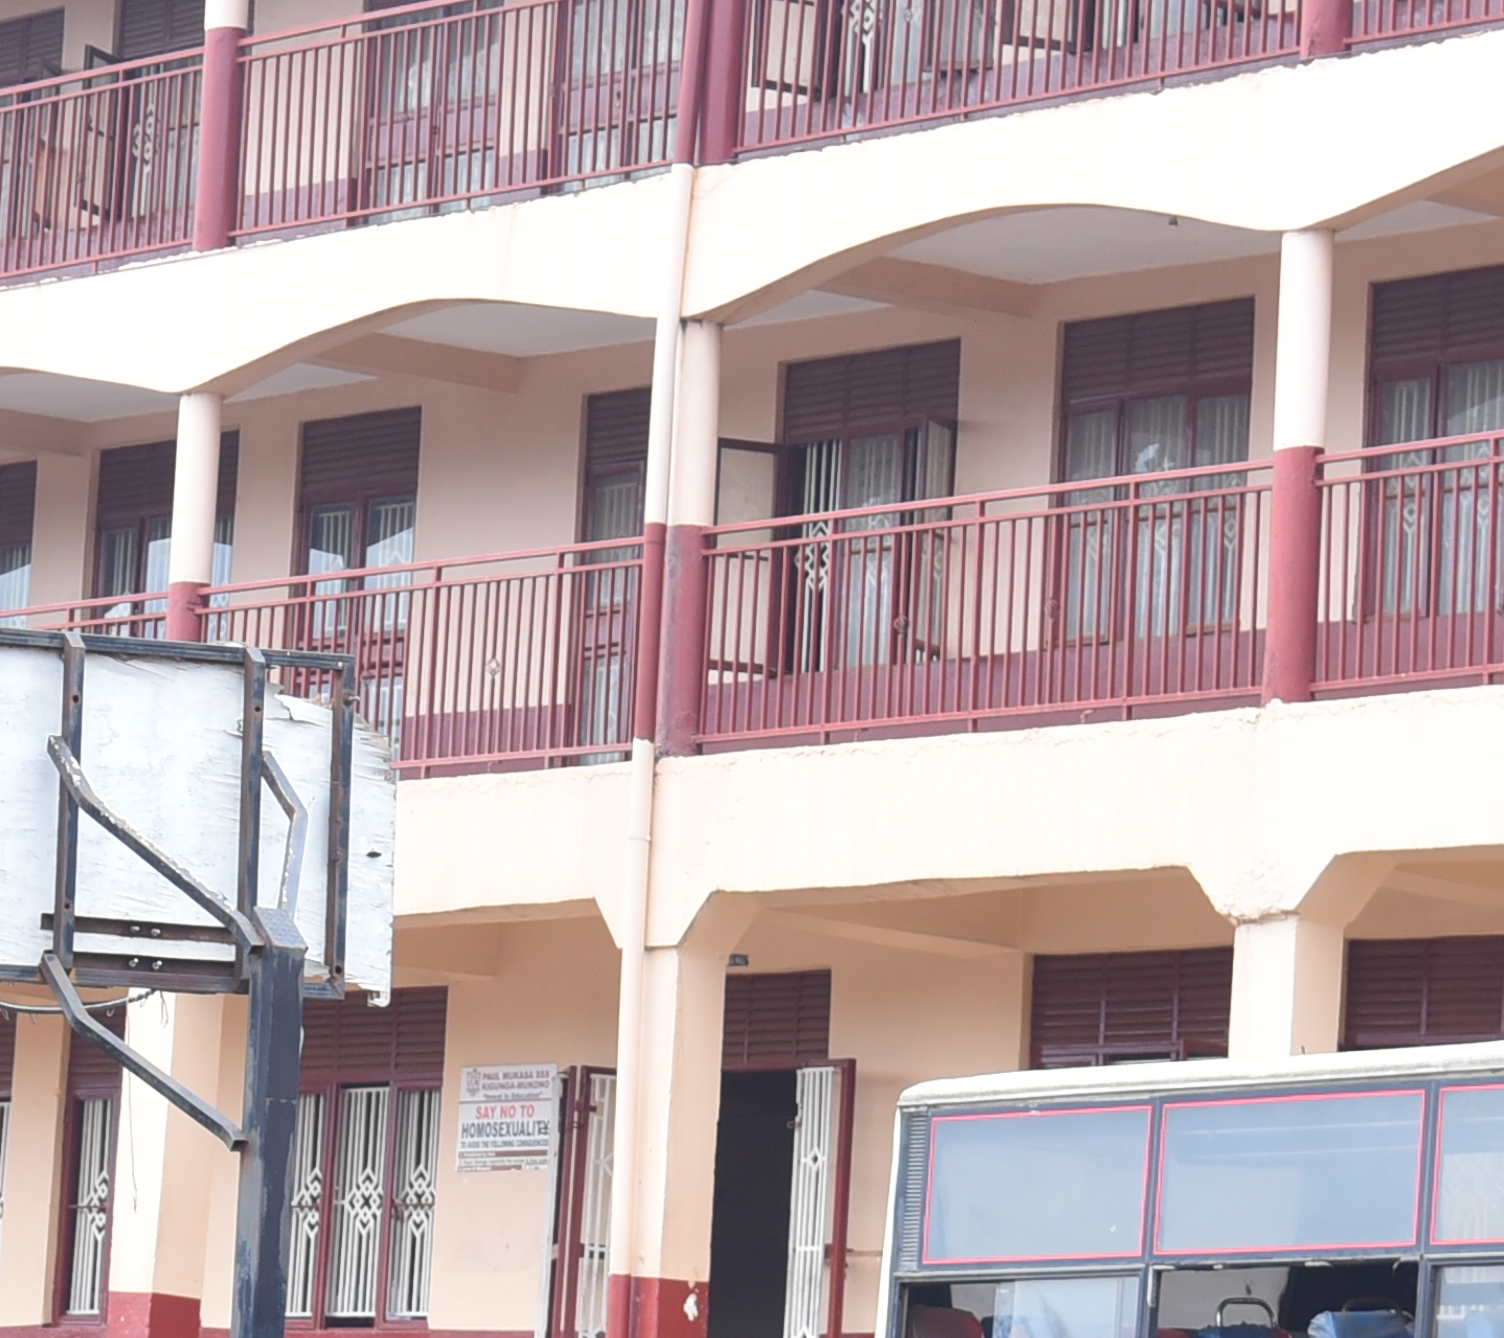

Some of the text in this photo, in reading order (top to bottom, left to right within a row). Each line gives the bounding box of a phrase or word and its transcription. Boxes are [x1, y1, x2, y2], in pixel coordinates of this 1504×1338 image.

[502, 1071, 533, 1080] MUKASA
[475, 1103, 535, 1120] SAY NO TO
[461, 1119, 550, 1139] HOMOSEXUALITY
